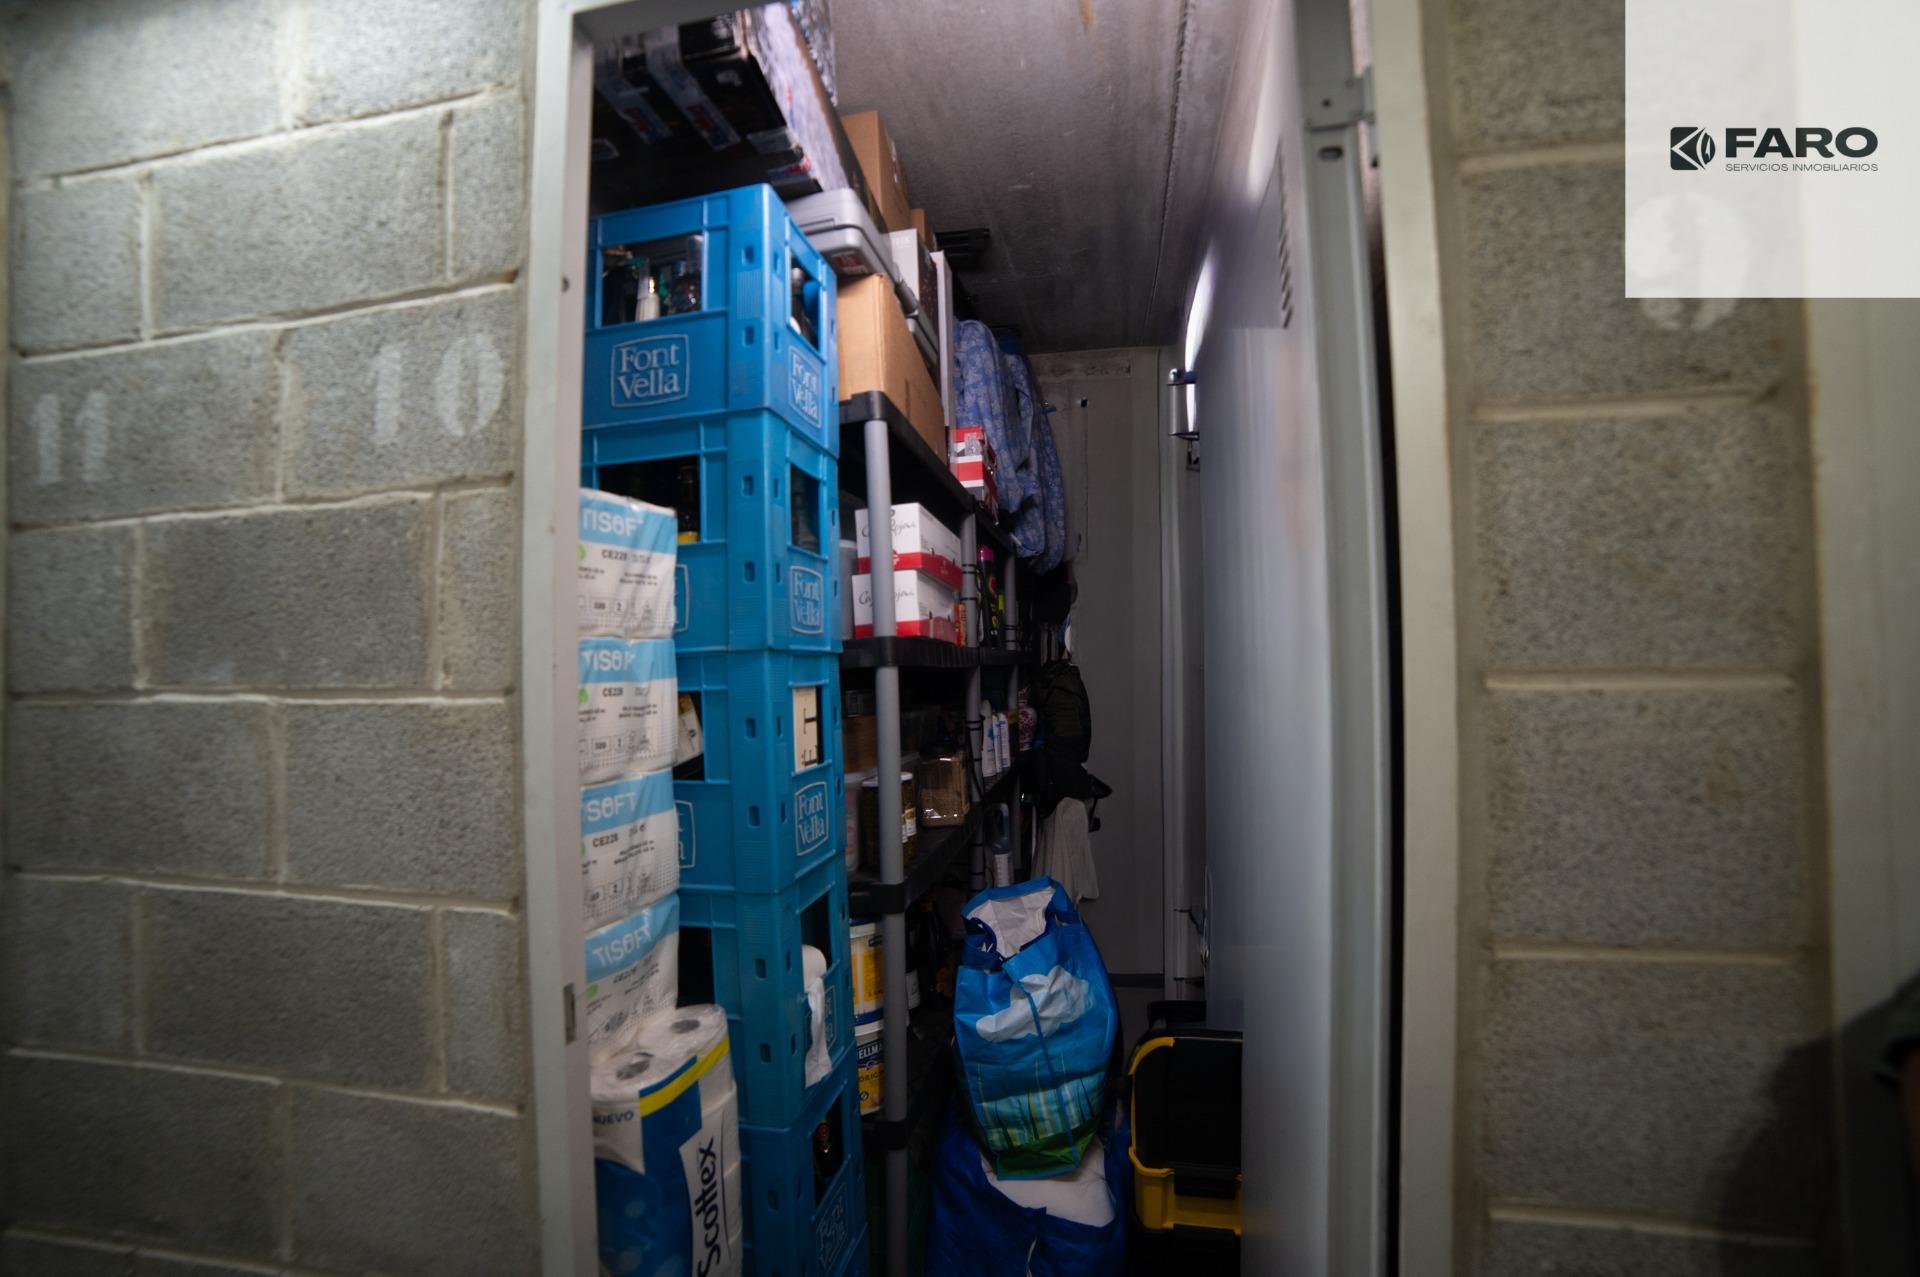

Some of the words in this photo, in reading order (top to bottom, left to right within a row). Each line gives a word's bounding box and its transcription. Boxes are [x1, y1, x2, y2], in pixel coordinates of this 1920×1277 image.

[619, 343, 680, 373] Font
[792, 354, 818, 388] Font
[367, 334, 503, 446] 10
[617, 368, 680, 400] Vella
[791, 378, 819, 417] Vella
[32, 391, 110, 486] 11
[794, 571, 819, 600] Font
[793, 598, 819, 627] Vella
[586, 792, 637, 822] SOFT
[799, 791, 824, 820] Font
[799, 814, 825, 846] Vella
[592, 922, 652, 968] TISOFT
[593, 1110, 634, 1125] NUEVO
[695, 1136, 720, 1277] Scottex
